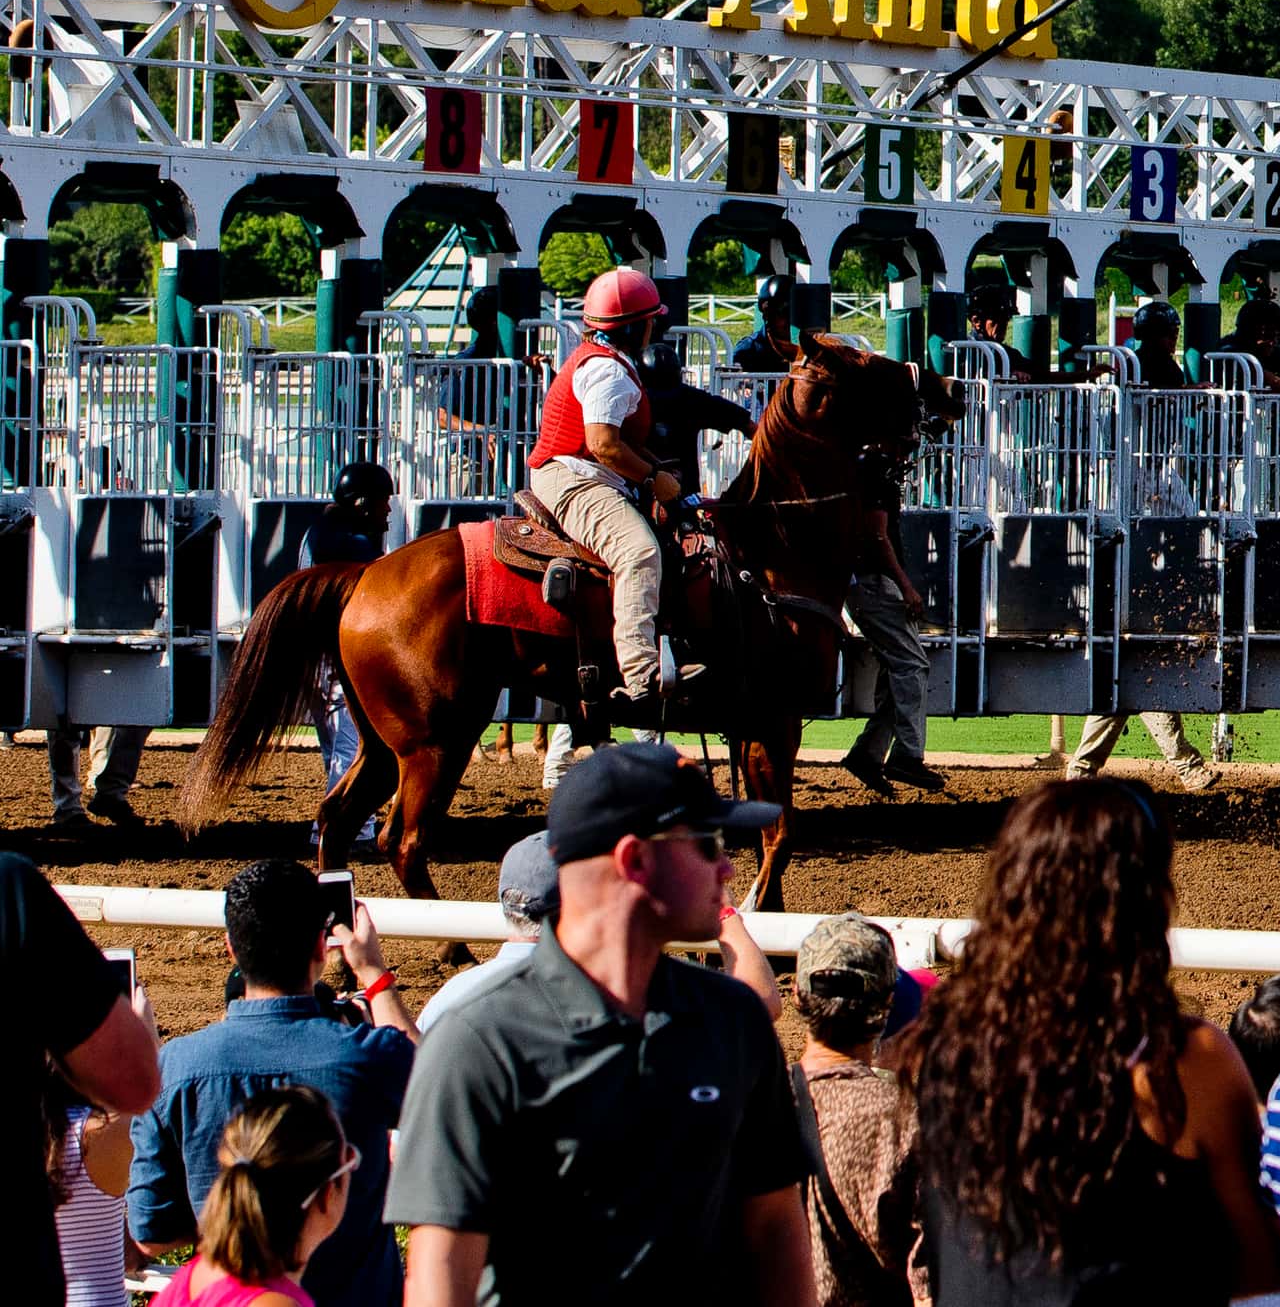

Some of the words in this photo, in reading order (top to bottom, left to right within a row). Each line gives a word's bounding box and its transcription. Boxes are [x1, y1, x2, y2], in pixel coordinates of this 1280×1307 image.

[439, 92, 465, 168] 8
[593, 103, 618, 179] 7
[878, 128, 901, 200] 5
[1015, 140, 1037, 209] 4
[1142, 149, 1164, 221] 3
